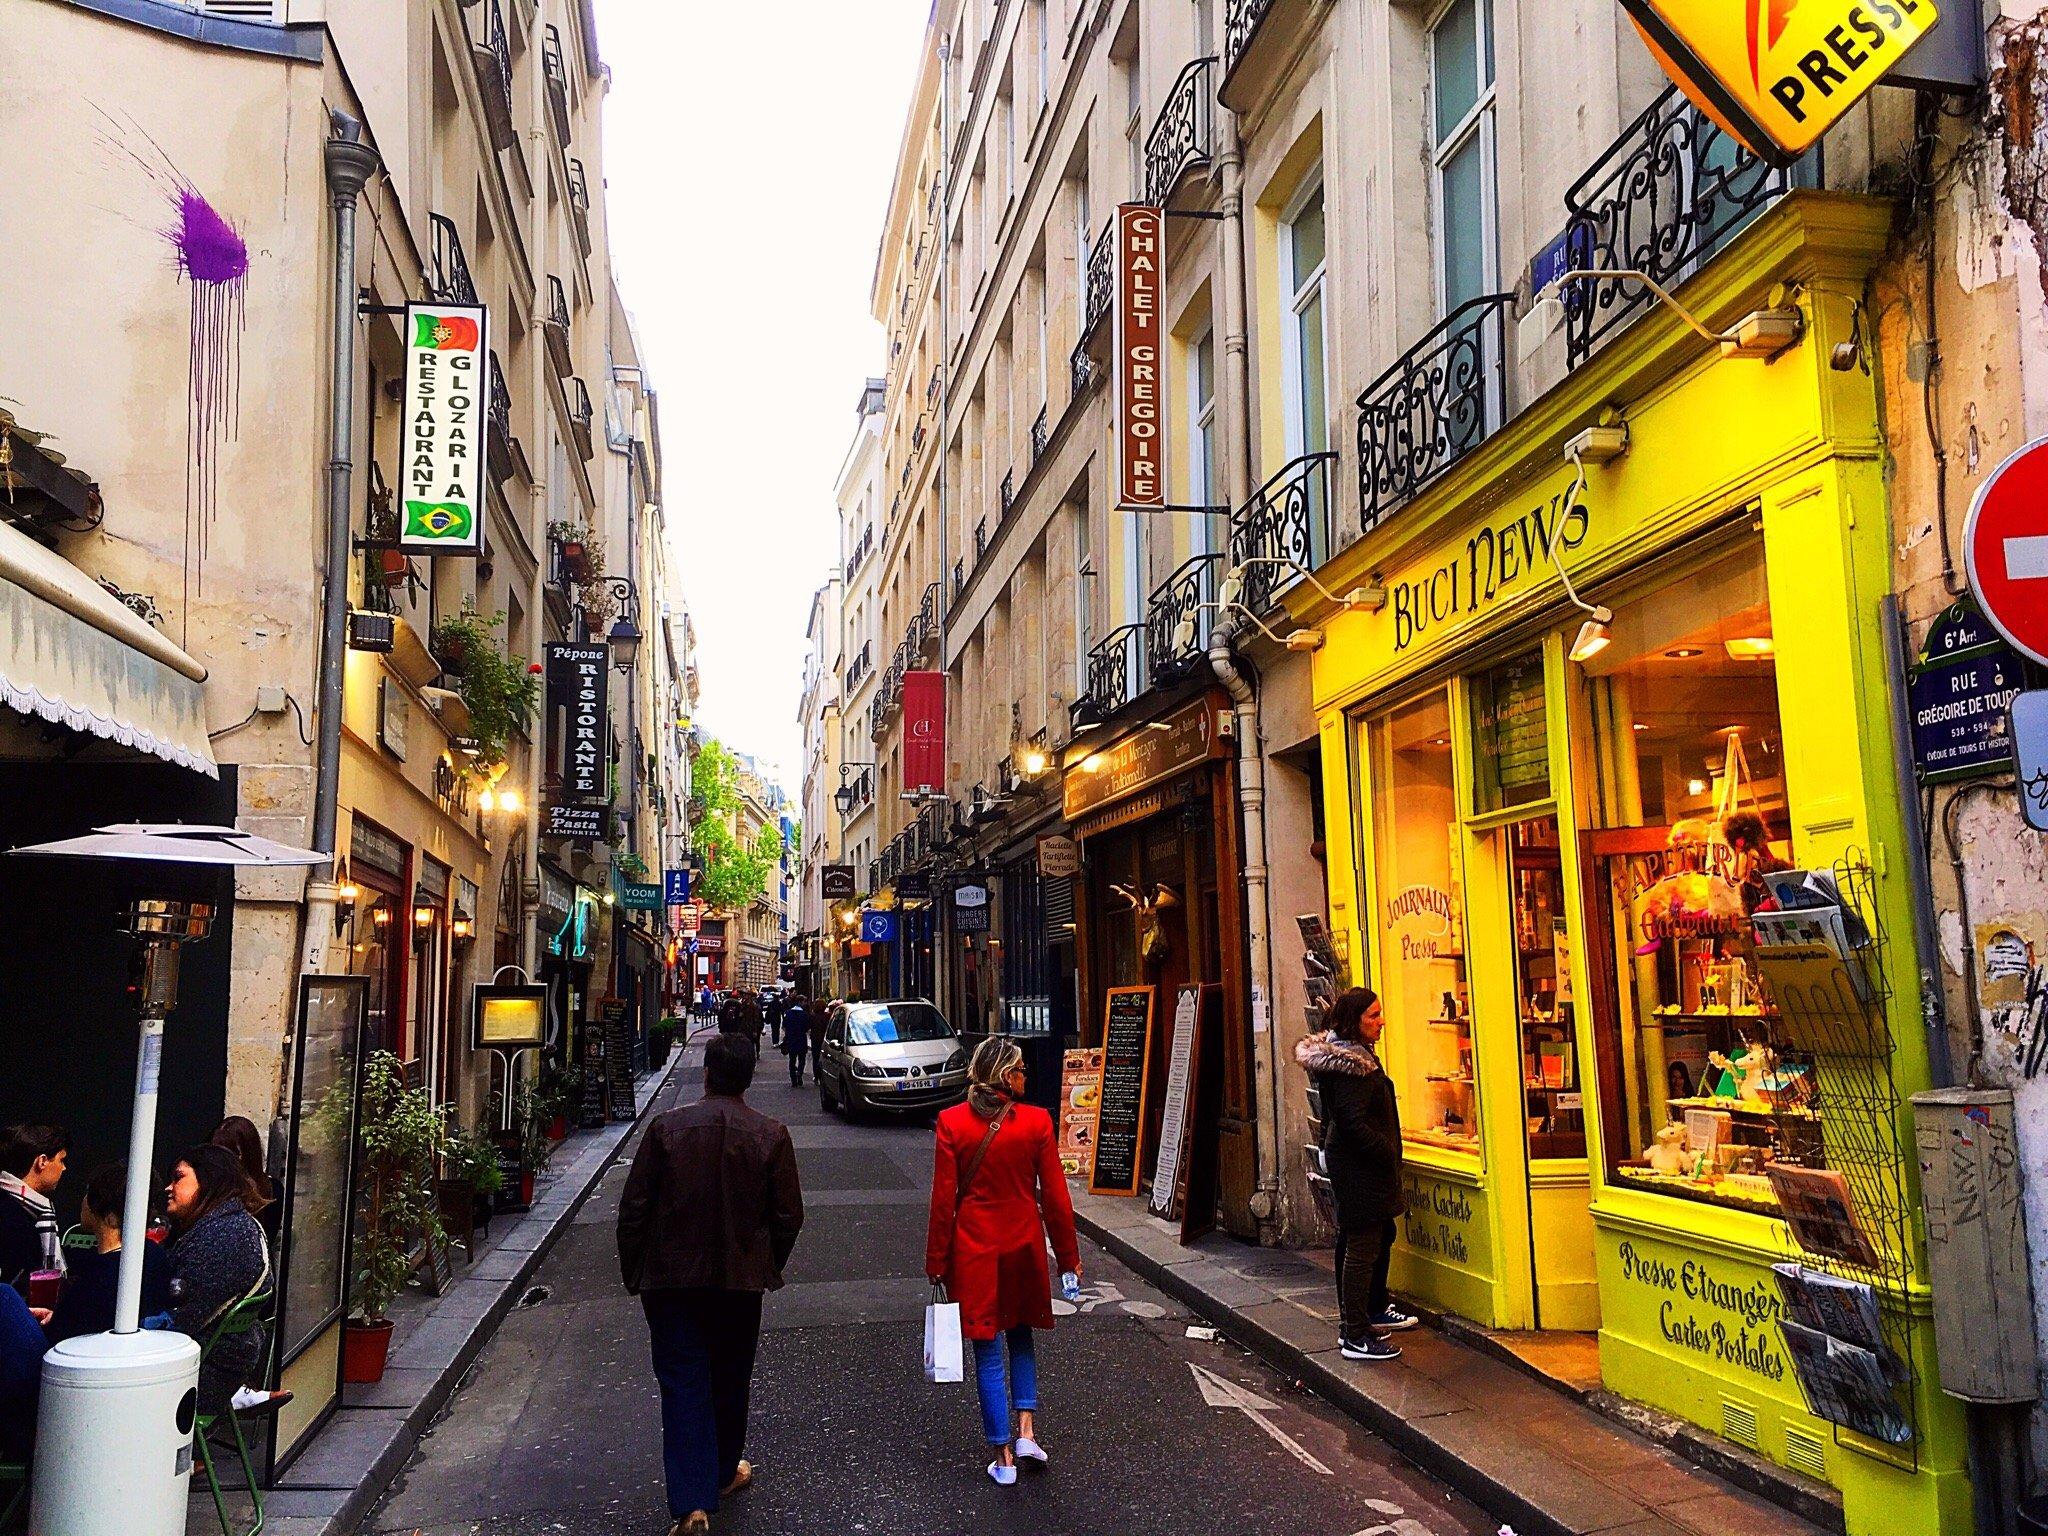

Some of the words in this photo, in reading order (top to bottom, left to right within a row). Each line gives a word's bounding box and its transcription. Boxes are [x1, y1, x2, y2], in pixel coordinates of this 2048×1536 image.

[1769, 0, 1918, 123] PRESS
[1131, 218, 1154, 329] CHALET
[412, 353, 437, 497] RESTAURANT
[445, 356, 471, 498] GLOZARIA
[1130, 345, 1156, 496] GREGOIRE
[1394, 559, 1459, 652] BUCI
[1466, 479, 1589, 612] NEWS
[554, 647, 604, 661] Pépone
[1951, 671, 1978, 692] RUE
[575, 664, 598, 790] RISTORANTE
[1917, 700, 1967, 727] GRÉGOIRE
[1968, 696, 1983, 714] DE
[1951, 728, 1965, 738] 538
[1973, 722, 1988, 733] 594
[1949, 746, 1957, 756] DE
[1958, 742, 1978, 755] TOURS
[1979, 740, 1986, 751] ET
[550, 807, 600, 819] Pizza
[551, 819, 597, 830] Pasta
[625, 888, 656, 898] YOOM
[1387, 886, 1453, 930] JOURNAUX
[1401, 934, 1438, 960] Presse
[1433, 1184, 1472, 1223] Cachets
[1619, 1241, 1676, 1292] Presse
[1660, 1301, 1711, 1353] Cartes
[1712, 1321, 1784, 1382] Postales
